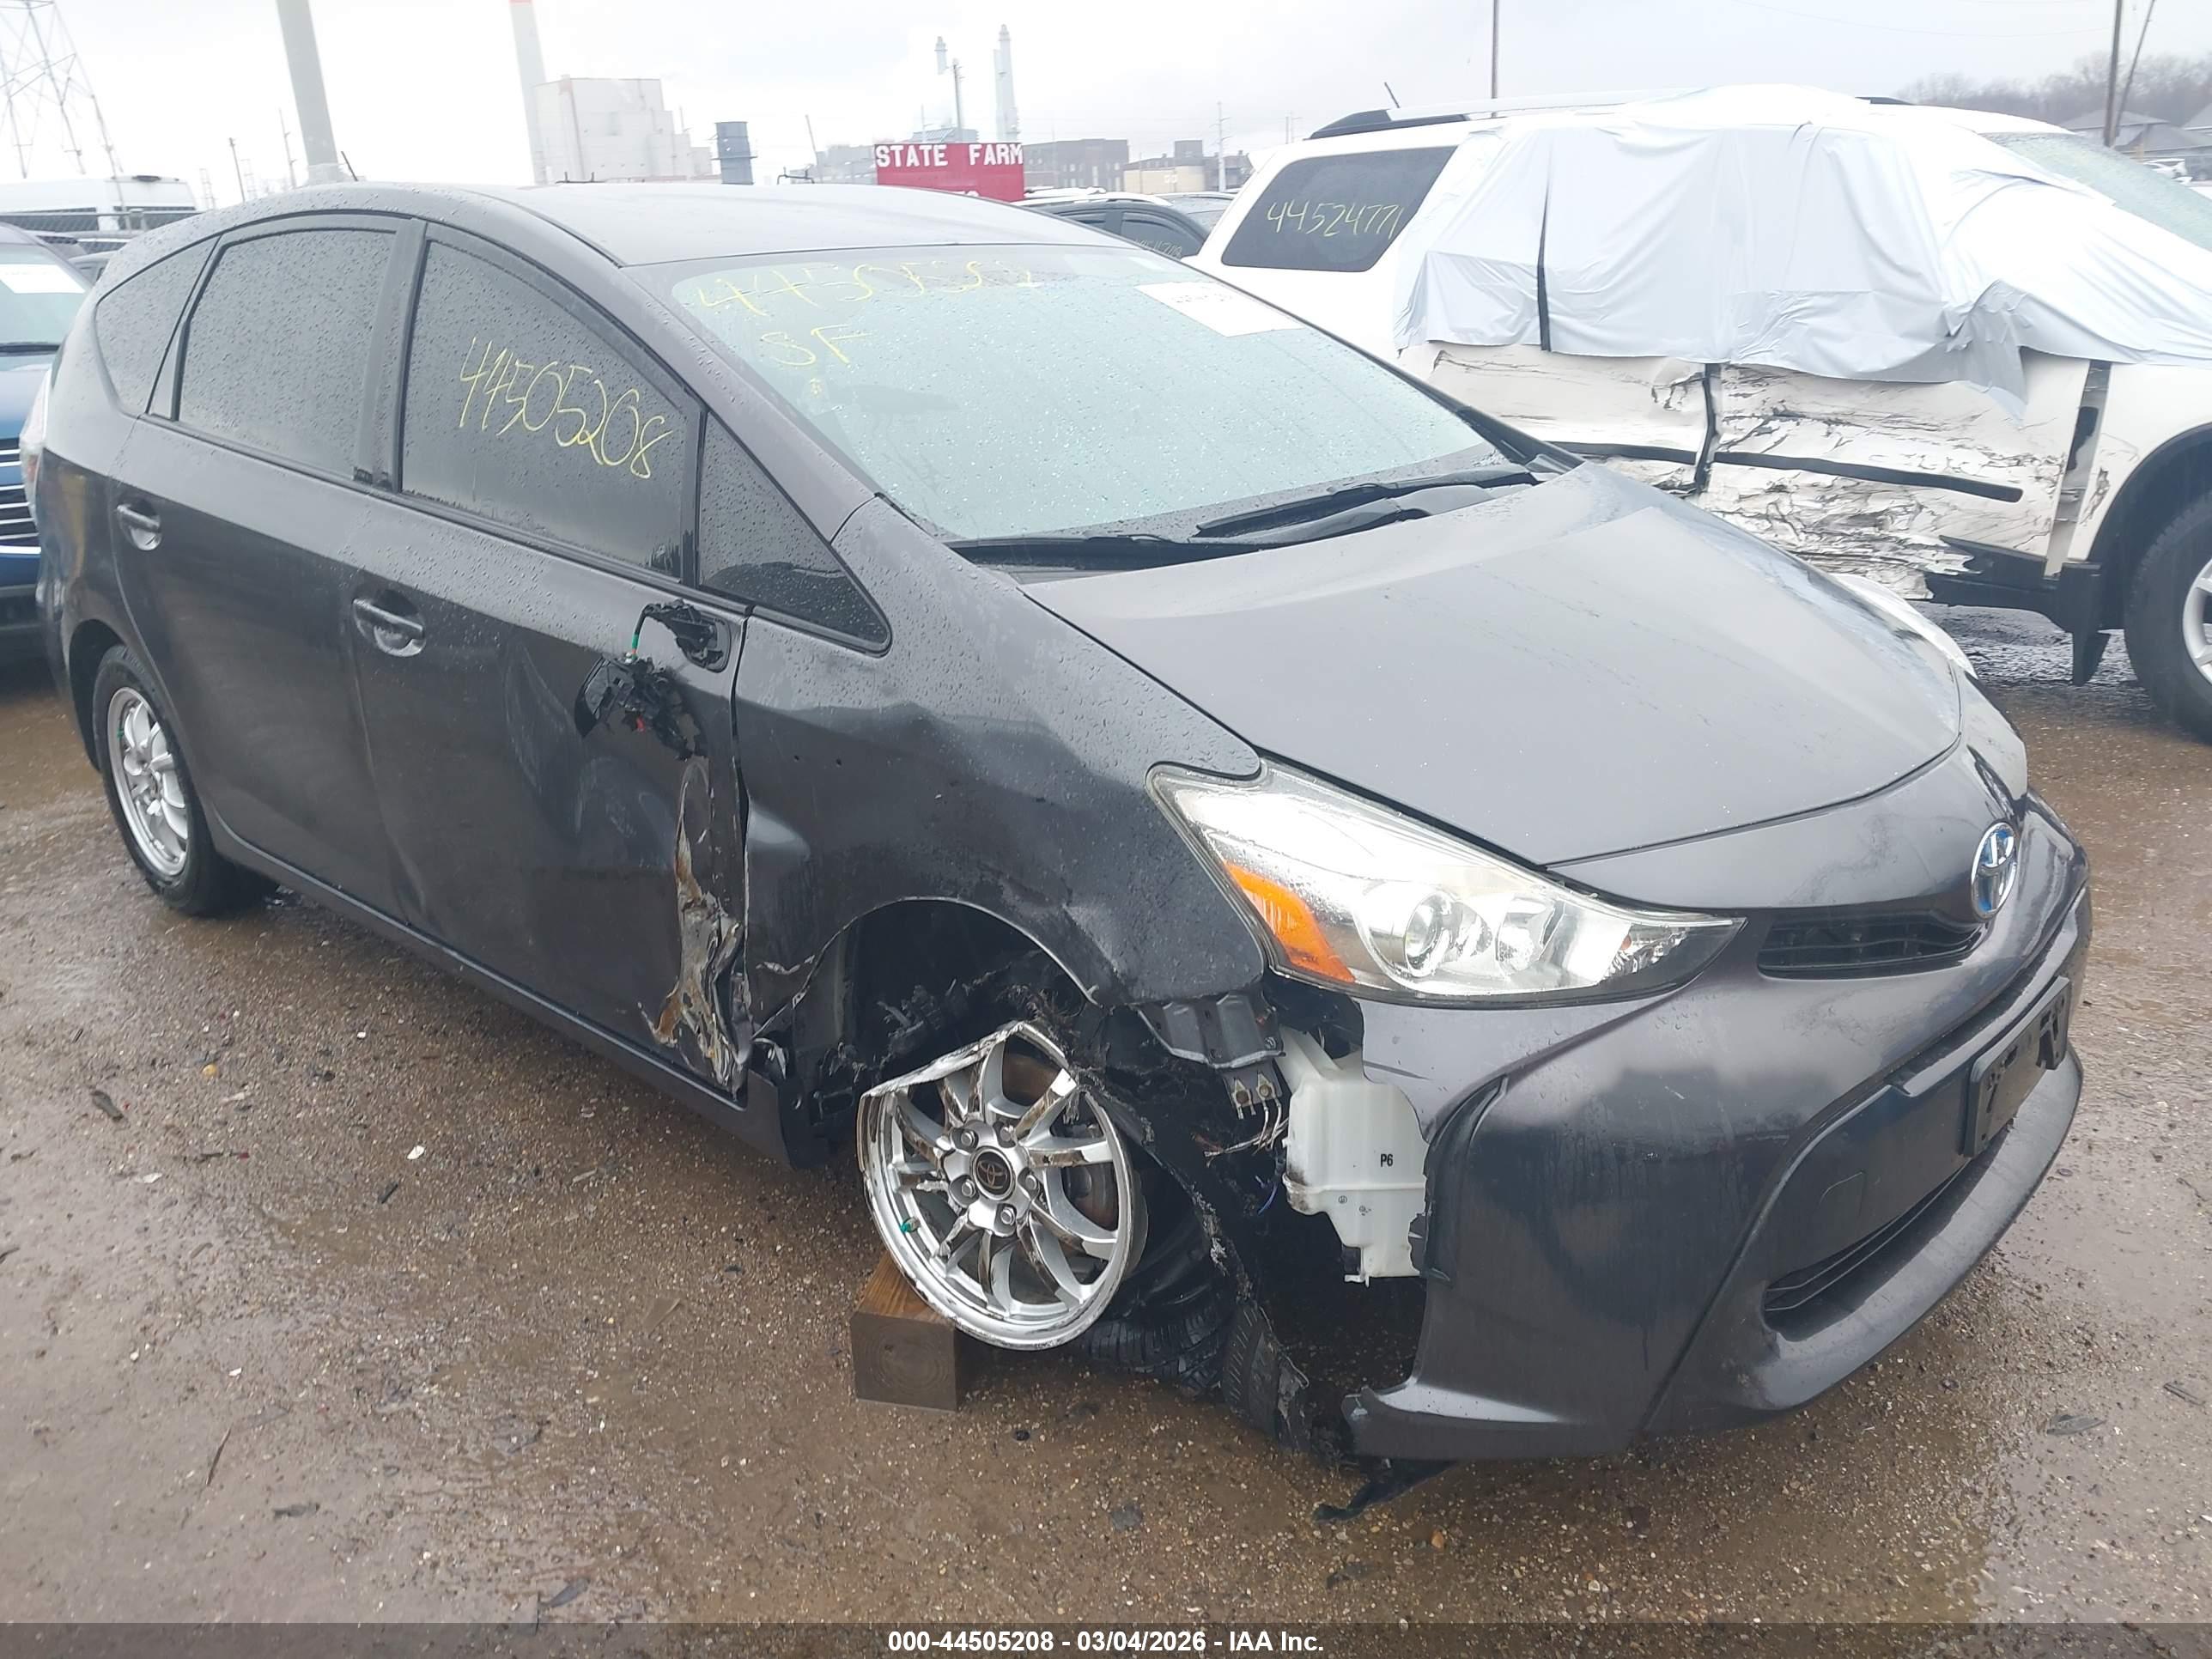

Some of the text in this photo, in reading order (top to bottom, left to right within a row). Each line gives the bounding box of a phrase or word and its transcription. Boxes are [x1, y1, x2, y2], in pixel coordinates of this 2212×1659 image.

[875, 143, 1024, 168] STATE FARM
[759, 323, 875, 368] SF
[459, 336, 674, 479] 44505208
[1380, 1153, 1394, 1168] P6
